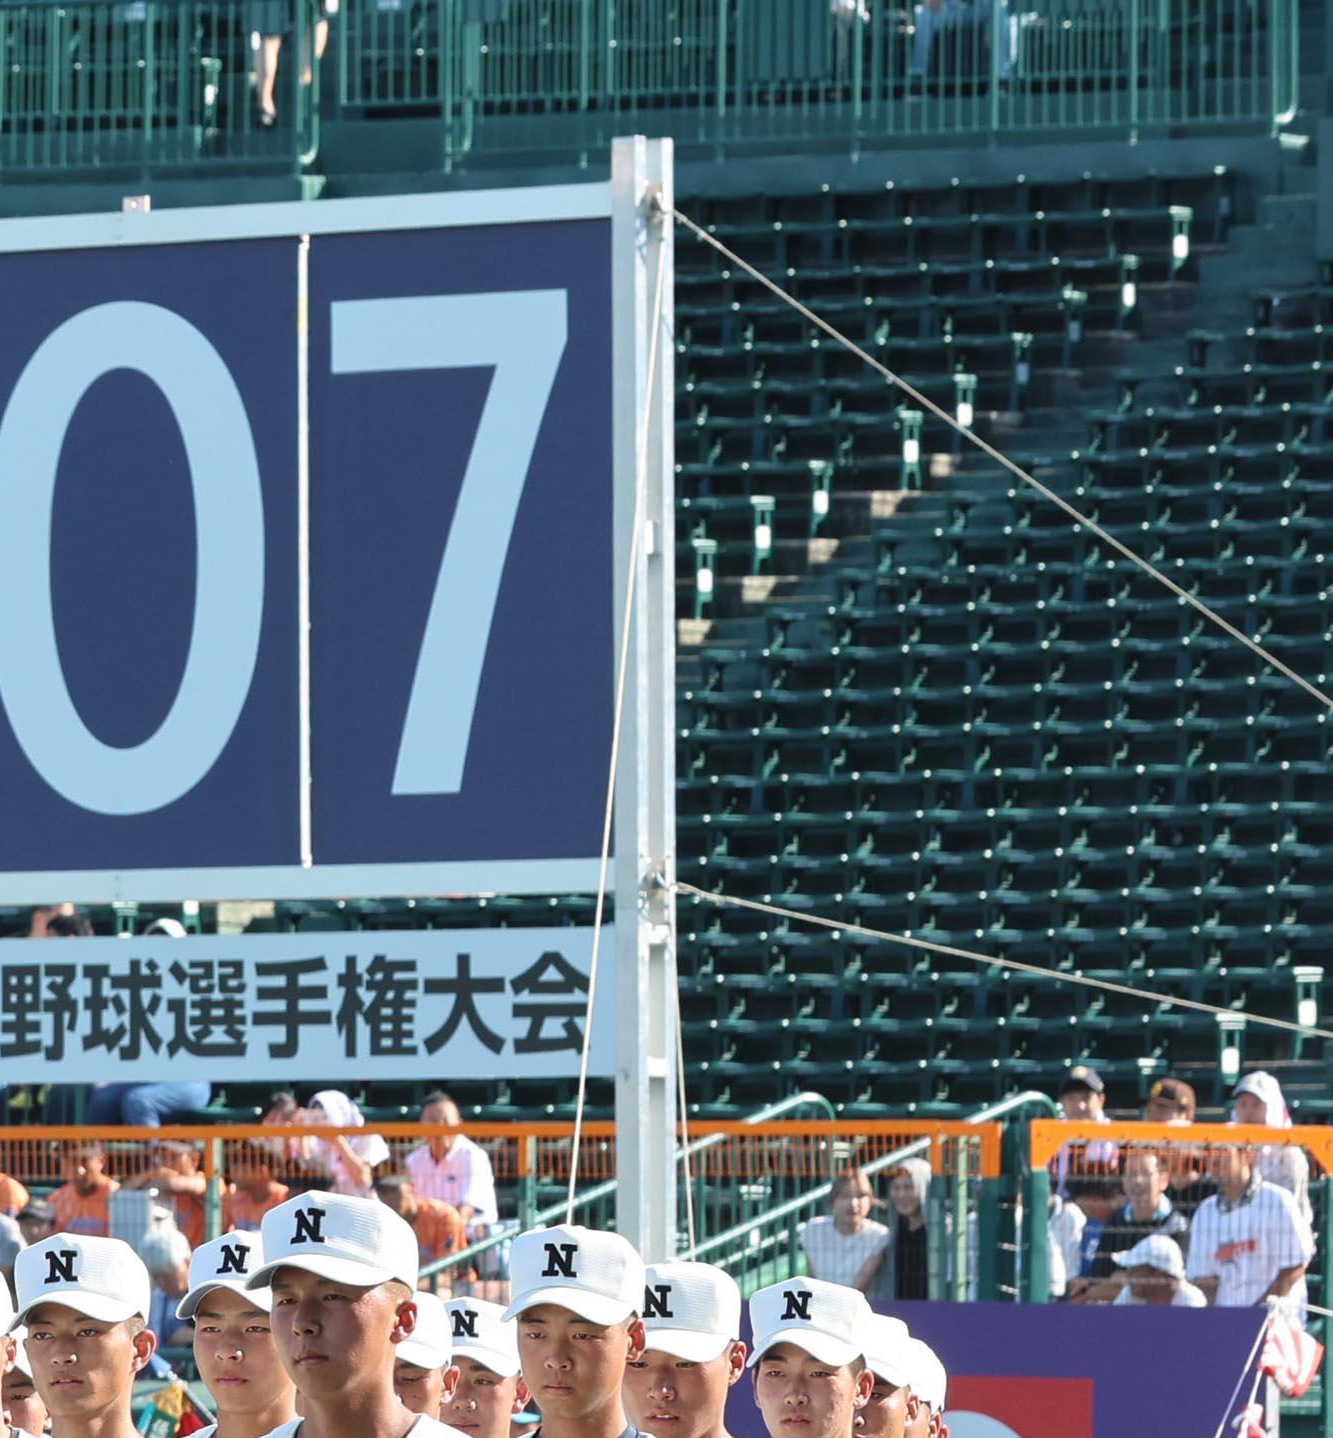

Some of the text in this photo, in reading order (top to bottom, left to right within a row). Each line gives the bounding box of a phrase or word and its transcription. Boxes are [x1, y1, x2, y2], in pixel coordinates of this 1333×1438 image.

[291, 1208, 325, 1244] N
[45, 1250, 77, 1284] N
[216, 1245, 250, 1273] N
[542, 1244, 577, 1278] N
[642, 1284, 673, 1318] N
[781, 1291, 812, 1320] N
[451, 1310, 479, 1337] N
